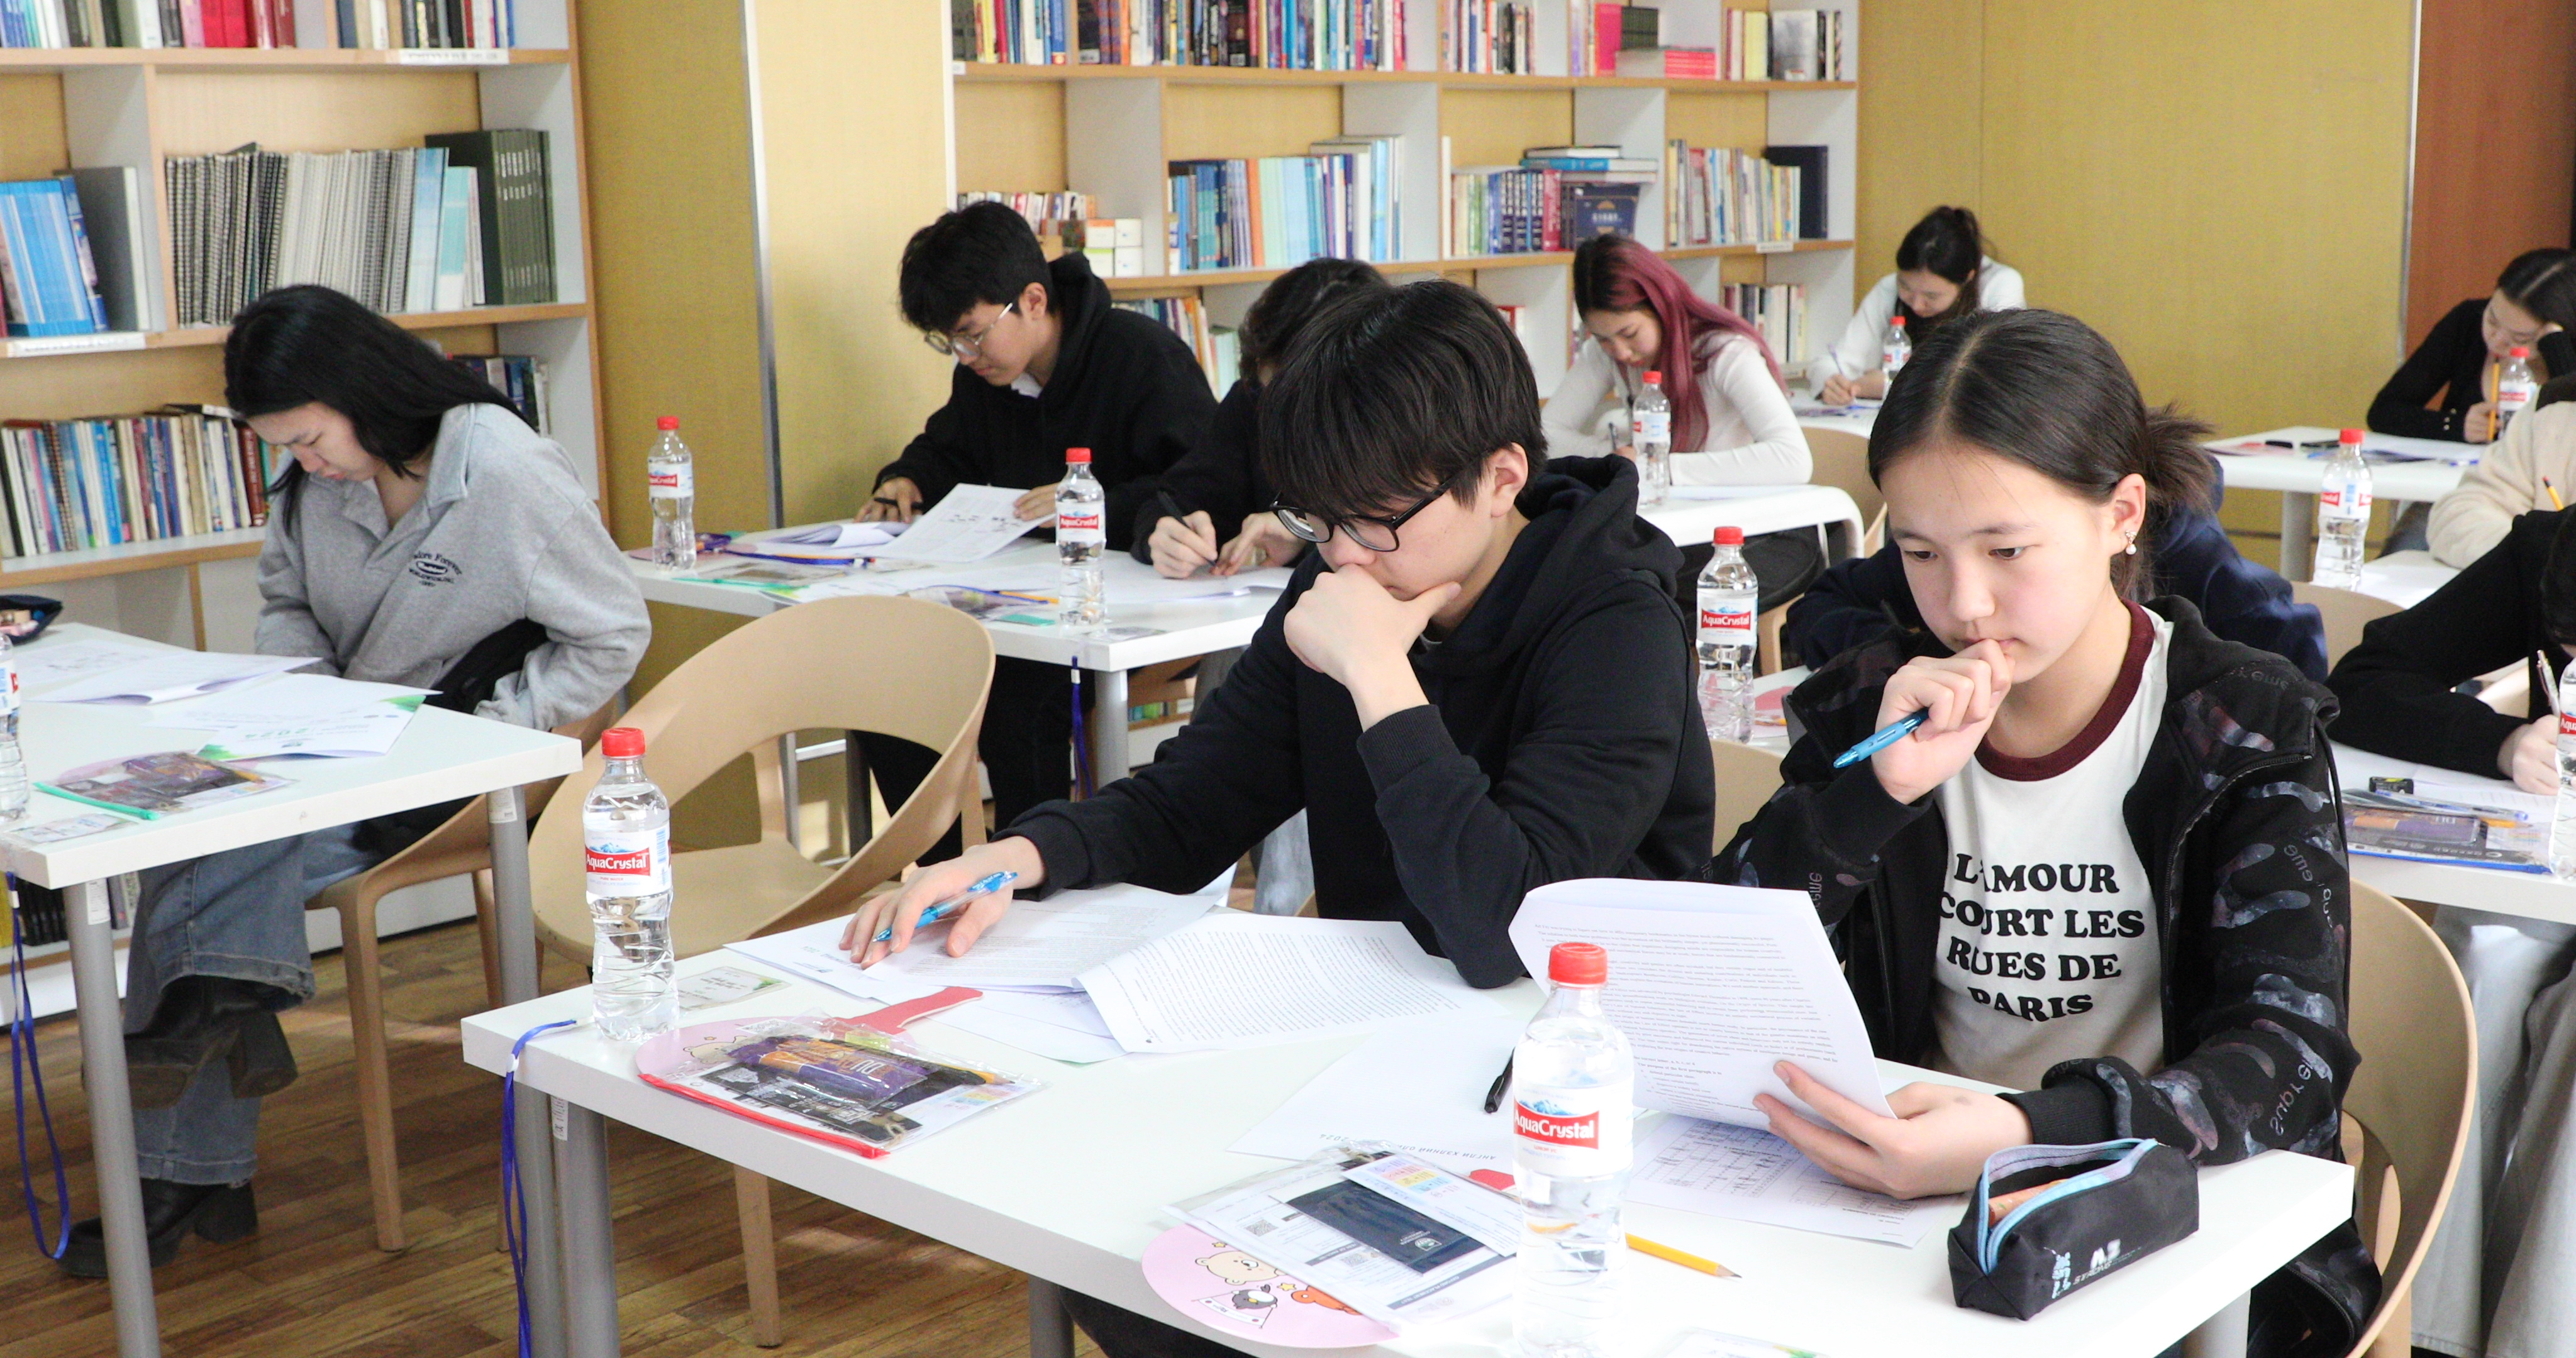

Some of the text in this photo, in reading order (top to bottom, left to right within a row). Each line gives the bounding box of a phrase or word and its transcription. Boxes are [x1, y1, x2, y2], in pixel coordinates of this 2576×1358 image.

[1702, 614, 1750, 627] AquaCrystal
[586, 854, 647, 871] AquaCrystal
[2064, 909, 2145, 938] LES
[1946, 936, 2122, 981] RUES DE
[1967, 986, 2093, 1022] PARIS
[1514, 1109, 1595, 1139] AquaCrystal
